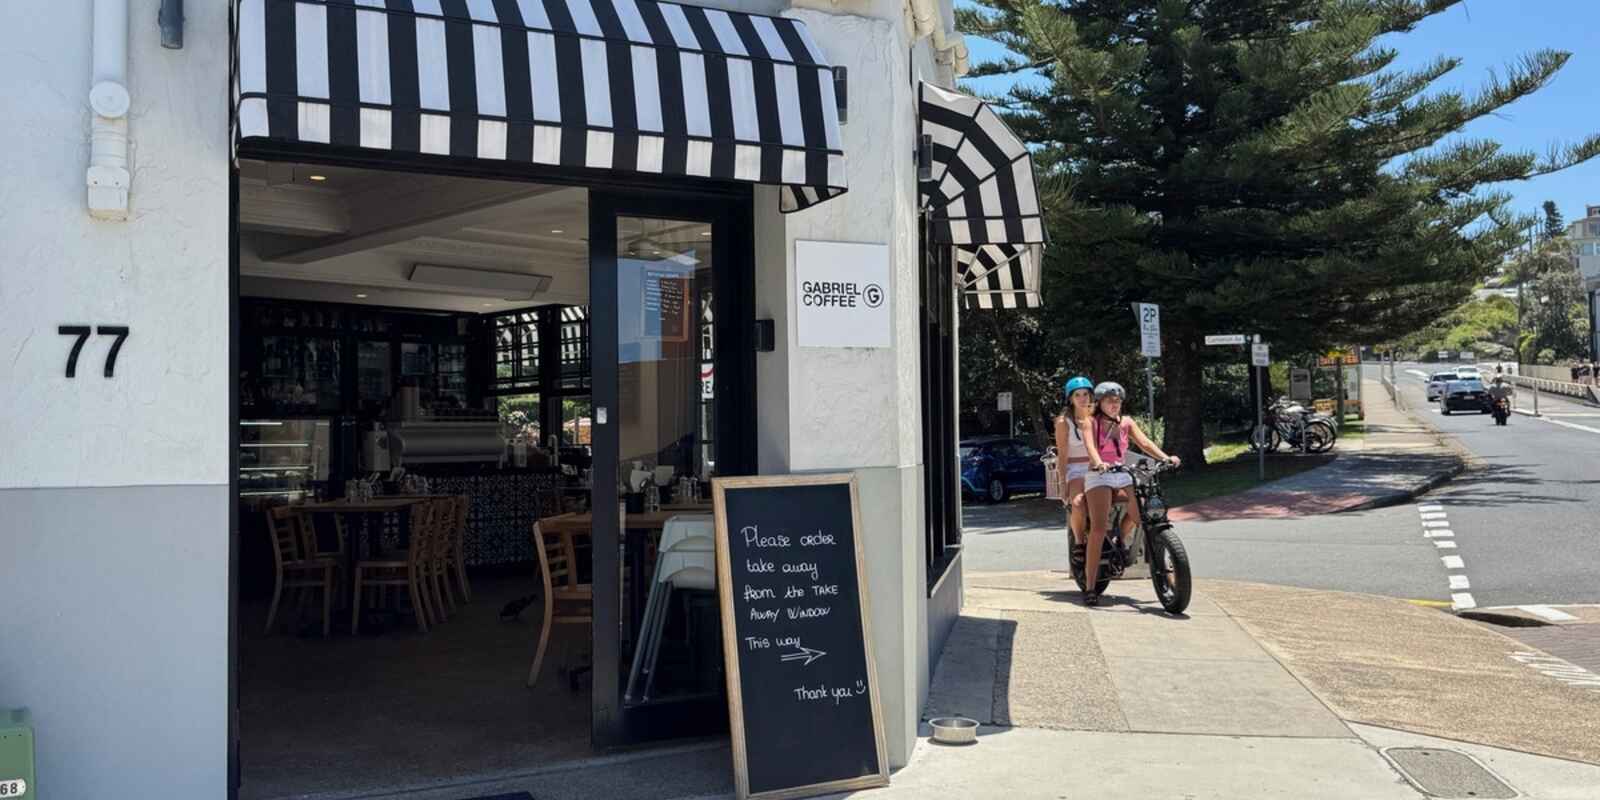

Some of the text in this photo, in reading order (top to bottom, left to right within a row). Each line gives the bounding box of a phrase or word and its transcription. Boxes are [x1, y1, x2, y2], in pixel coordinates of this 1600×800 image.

[802, 281, 861, 296] GABRIEL
[803, 294, 857, 308] COFFEE
[1143, 307, 1157, 323] 2P
[58, 325, 129, 378] 77
[740, 525, 837, 548] Please order
[746, 558, 819, 581] take away
[784, 585, 805, 599] the
[811, 584, 839, 596] TAKE
[750, 607, 780, 622] AWAY
[745, 636, 801, 651] This way
[793, 684, 853, 705] Thank you
